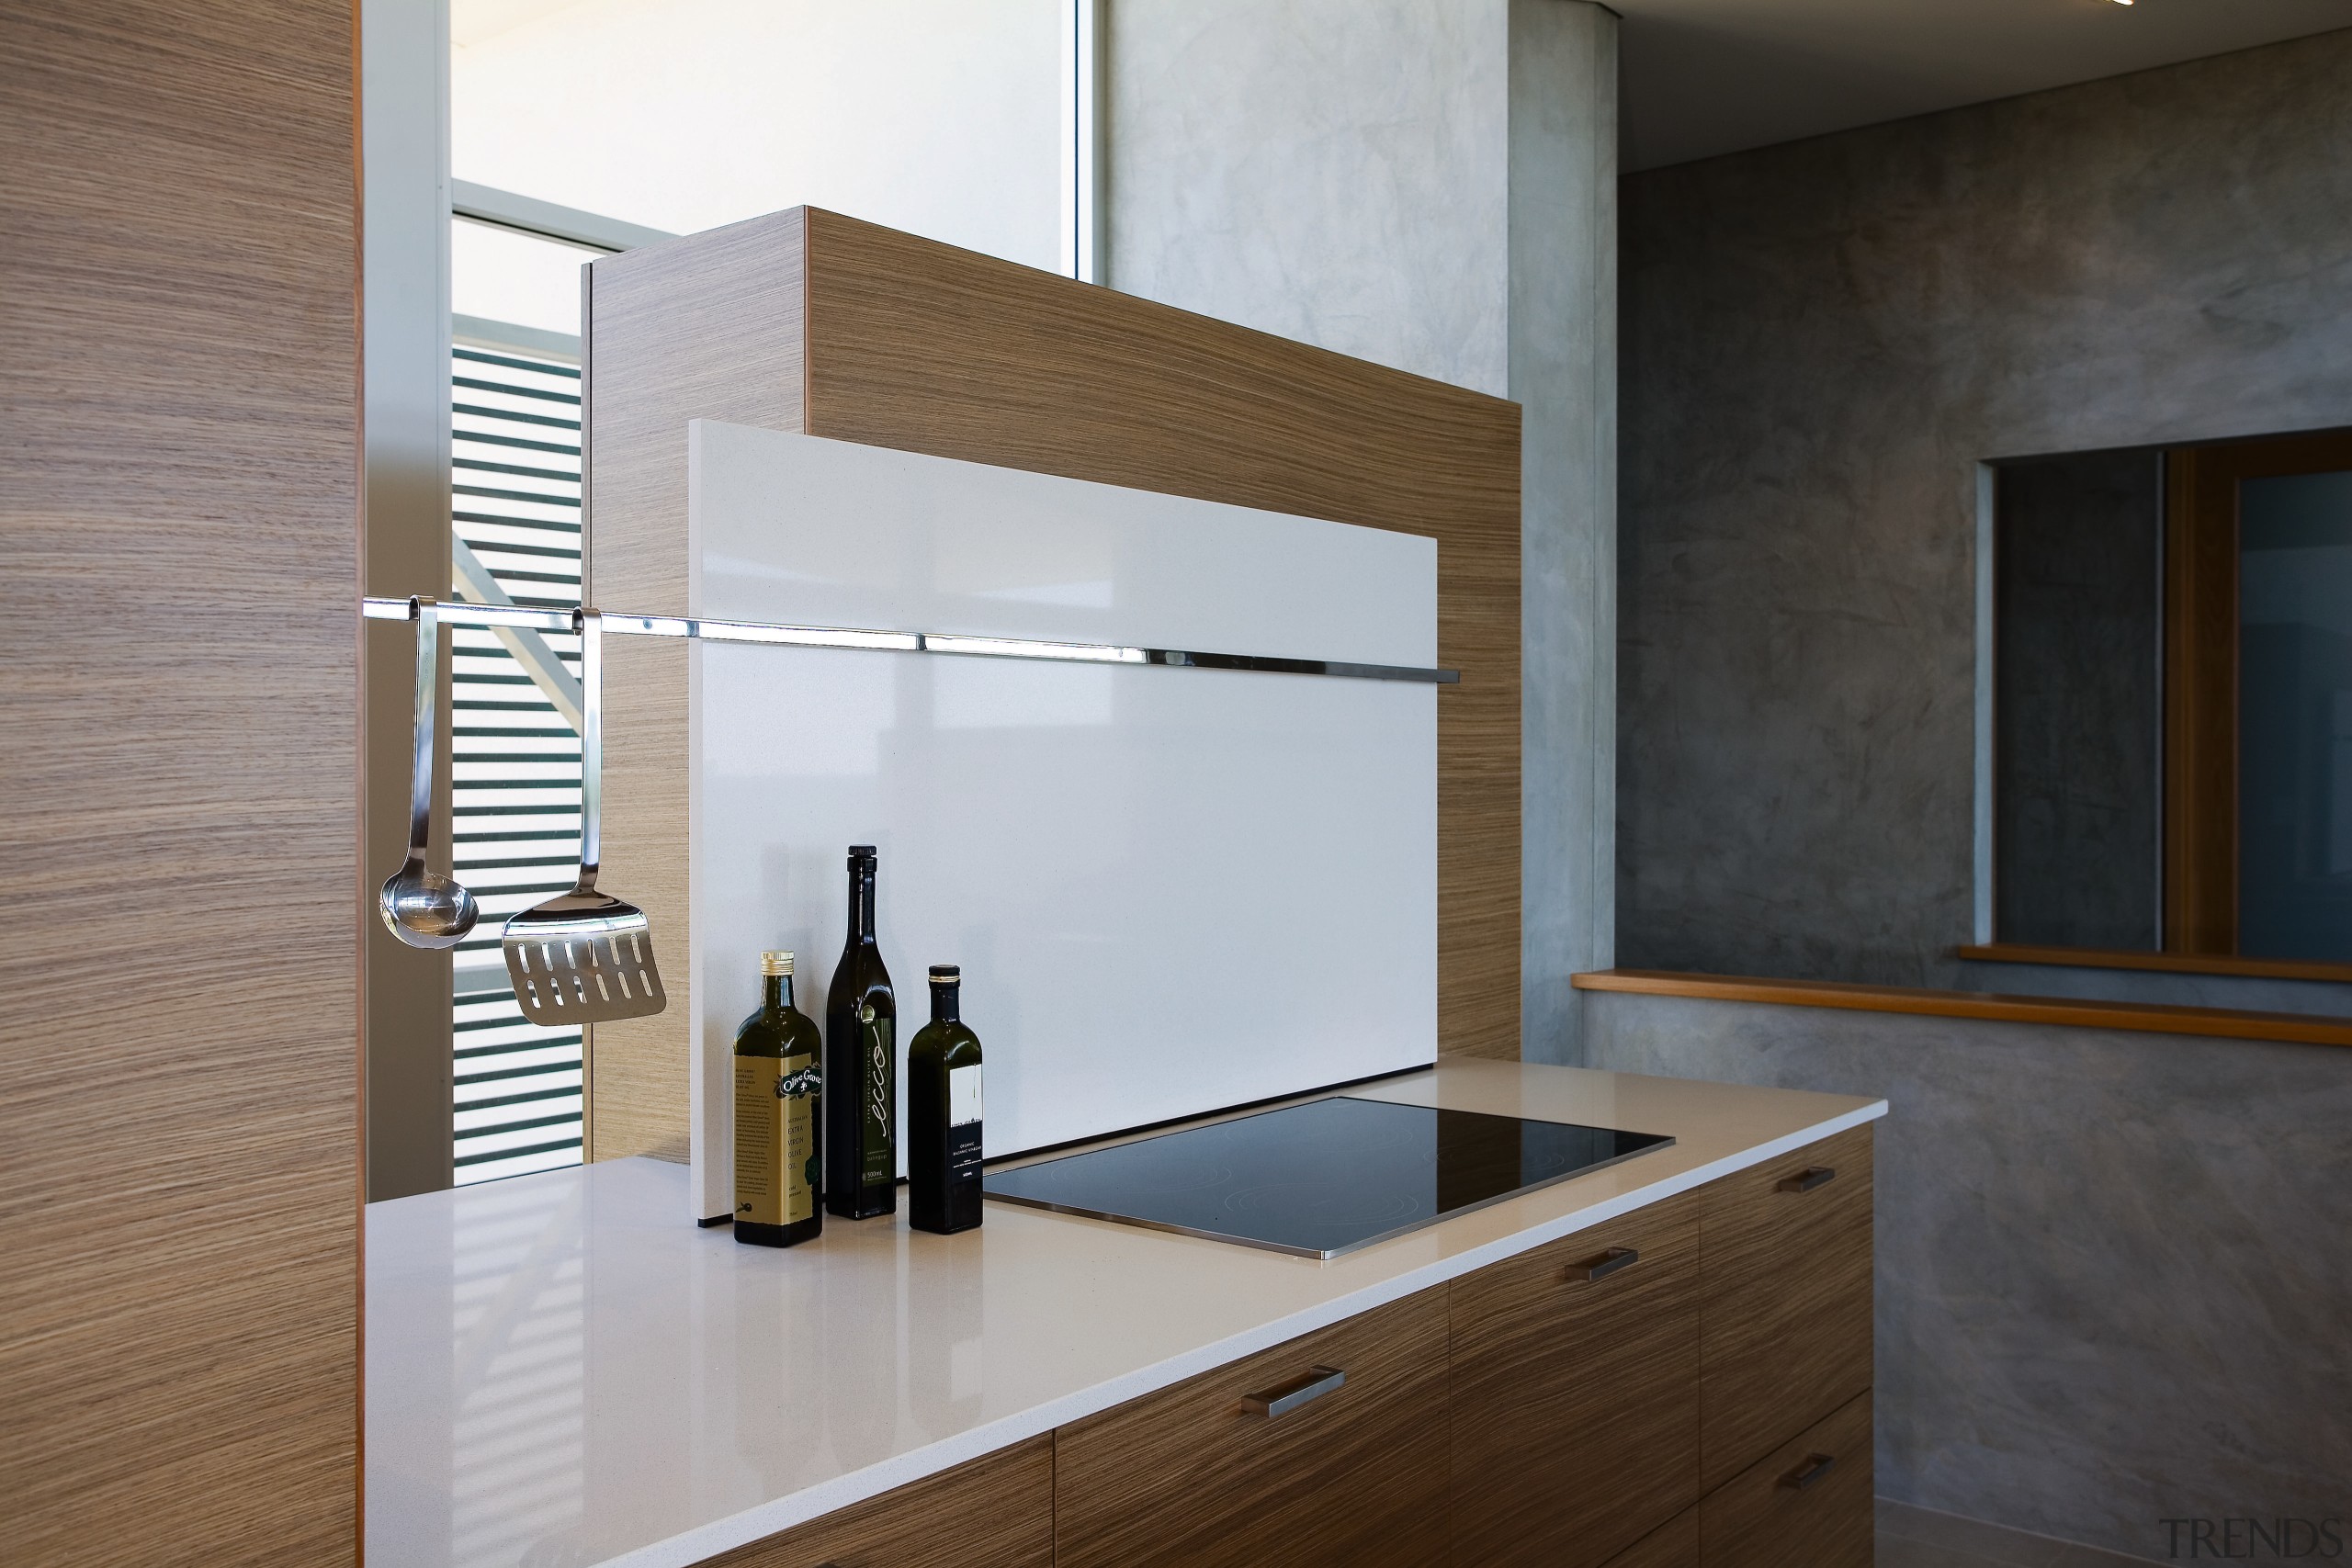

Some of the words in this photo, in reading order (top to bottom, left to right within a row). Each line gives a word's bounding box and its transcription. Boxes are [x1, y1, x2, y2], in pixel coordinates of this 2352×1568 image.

[783, 1074, 803, 1091] Olive
[803, 1069, 822, 1084] Grove
[871, 1025, 887, 1137] ecco
[787, 1125, 804, 1134] EXTRA
[787, 1136, 804, 1146] VIRGIN
[788, 1149, 802, 1158] OLIVE
